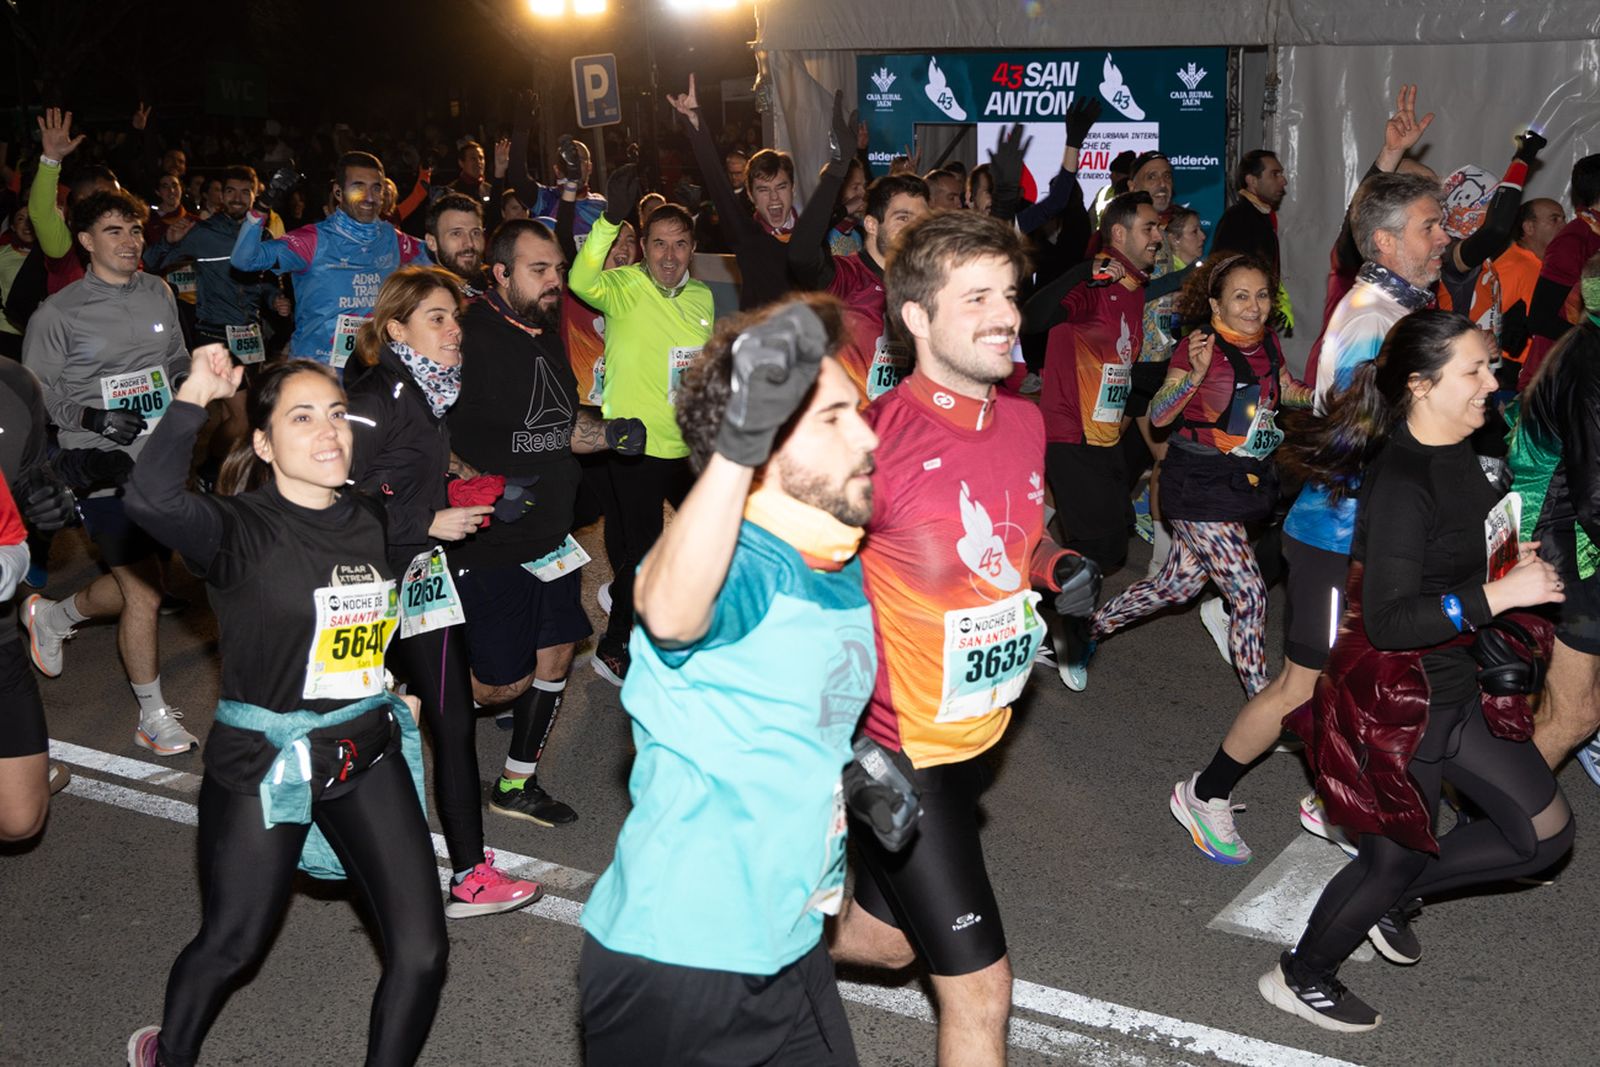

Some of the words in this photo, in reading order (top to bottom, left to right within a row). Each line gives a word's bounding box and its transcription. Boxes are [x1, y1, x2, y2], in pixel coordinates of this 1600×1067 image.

[992, 62, 1024, 90] 43
[1024, 61, 1079, 87] SAN
[583, 64, 609, 118] P
[984, 83, 1075, 116] ANTÓN
[1112, 90, 1131, 110] 43
[1170, 91, 1187, 99] CAJA
[1189, 91, 1213, 99] RURAL
[937, 92, 953, 110] 43
[1100, 141, 1112, 150] DE
[352, 273, 381, 285] ADRA
[112, 389, 127, 398] SAN
[978, 547, 1002, 578] 43
[343, 598, 373, 611] NOCHE
[329, 614, 350, 628] SAN
[974, 617, 1005, 632] NOCHE
[1006, 609, 1016, 624] DE
[958, 635, 982, 649] SAN
[965, 633, 1032, 683] 3633
